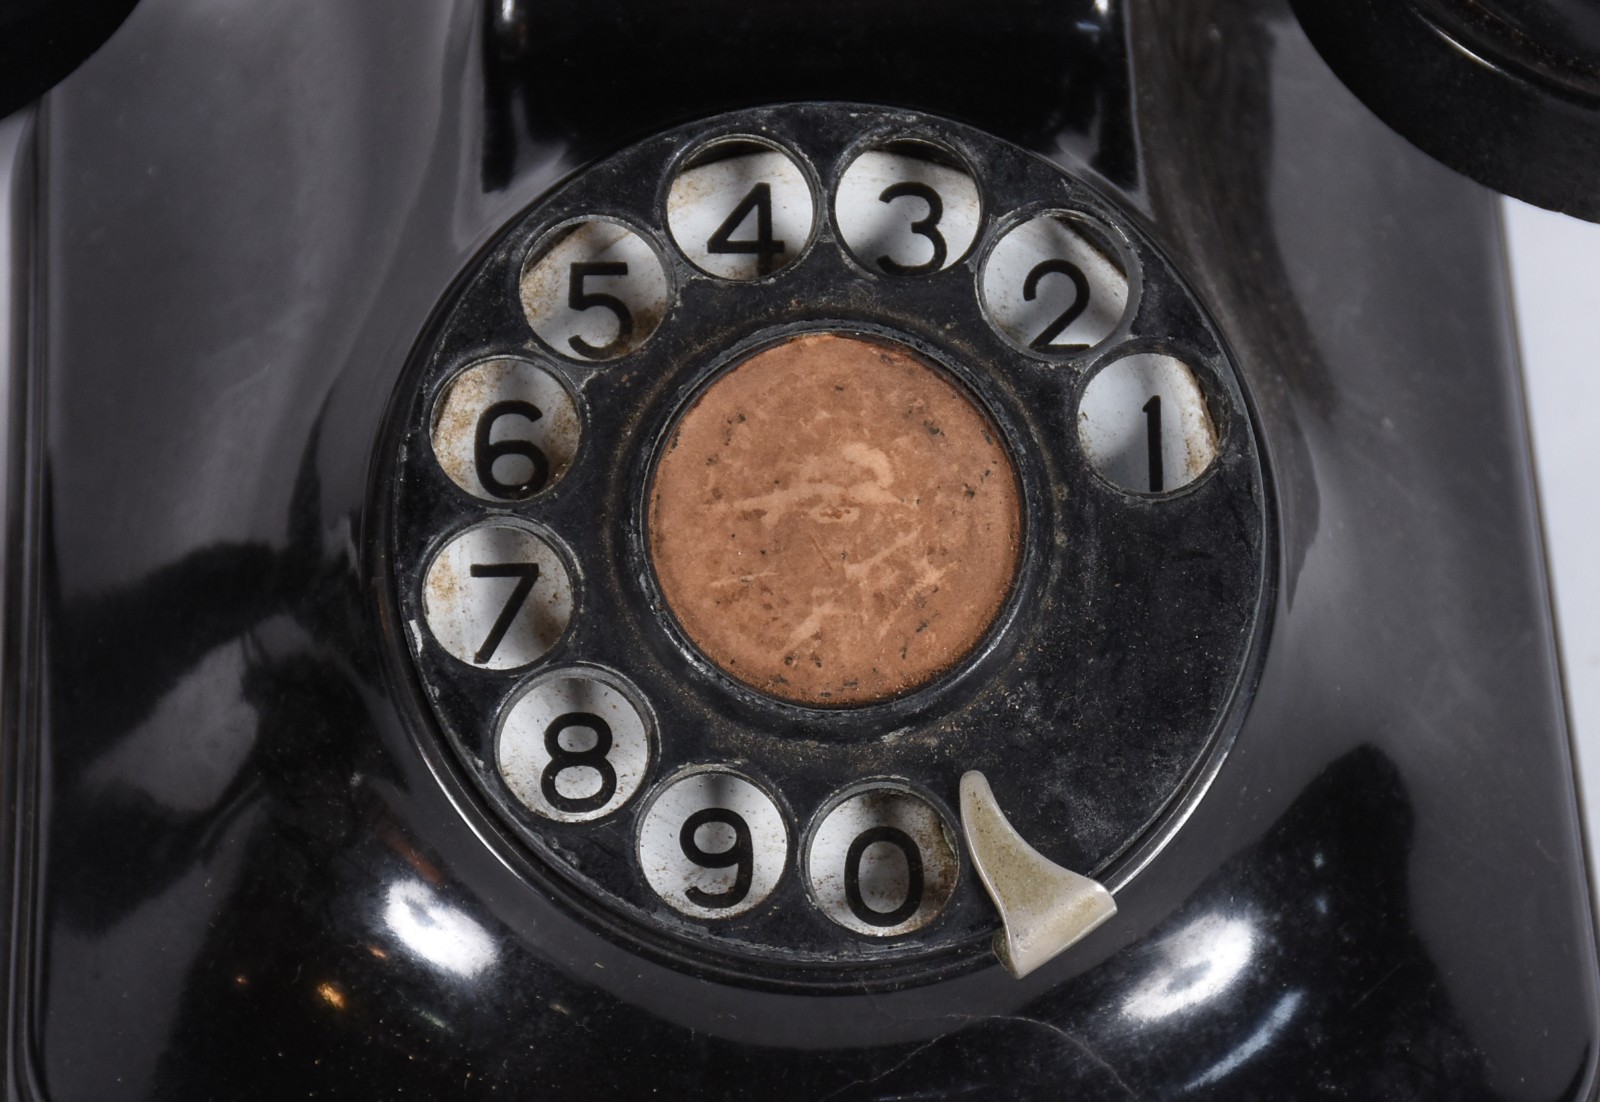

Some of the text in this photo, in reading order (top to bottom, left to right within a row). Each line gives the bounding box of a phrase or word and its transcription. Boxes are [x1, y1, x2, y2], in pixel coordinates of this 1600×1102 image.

[708, 183, 785, 274] 4
[877, 181, 946, 275] 3
[568, 262, 634, 354] 5
[1024, 259, 1090, 350] 2
[475, 399, 549, 498] 6
[1143, 396, 1164, 492] 1
[471, 563, 539, 664] 7
[542, 712, 617, 812] 8
[680, 808, 753, 908] 9
[845, 827, 925, 926] 0
